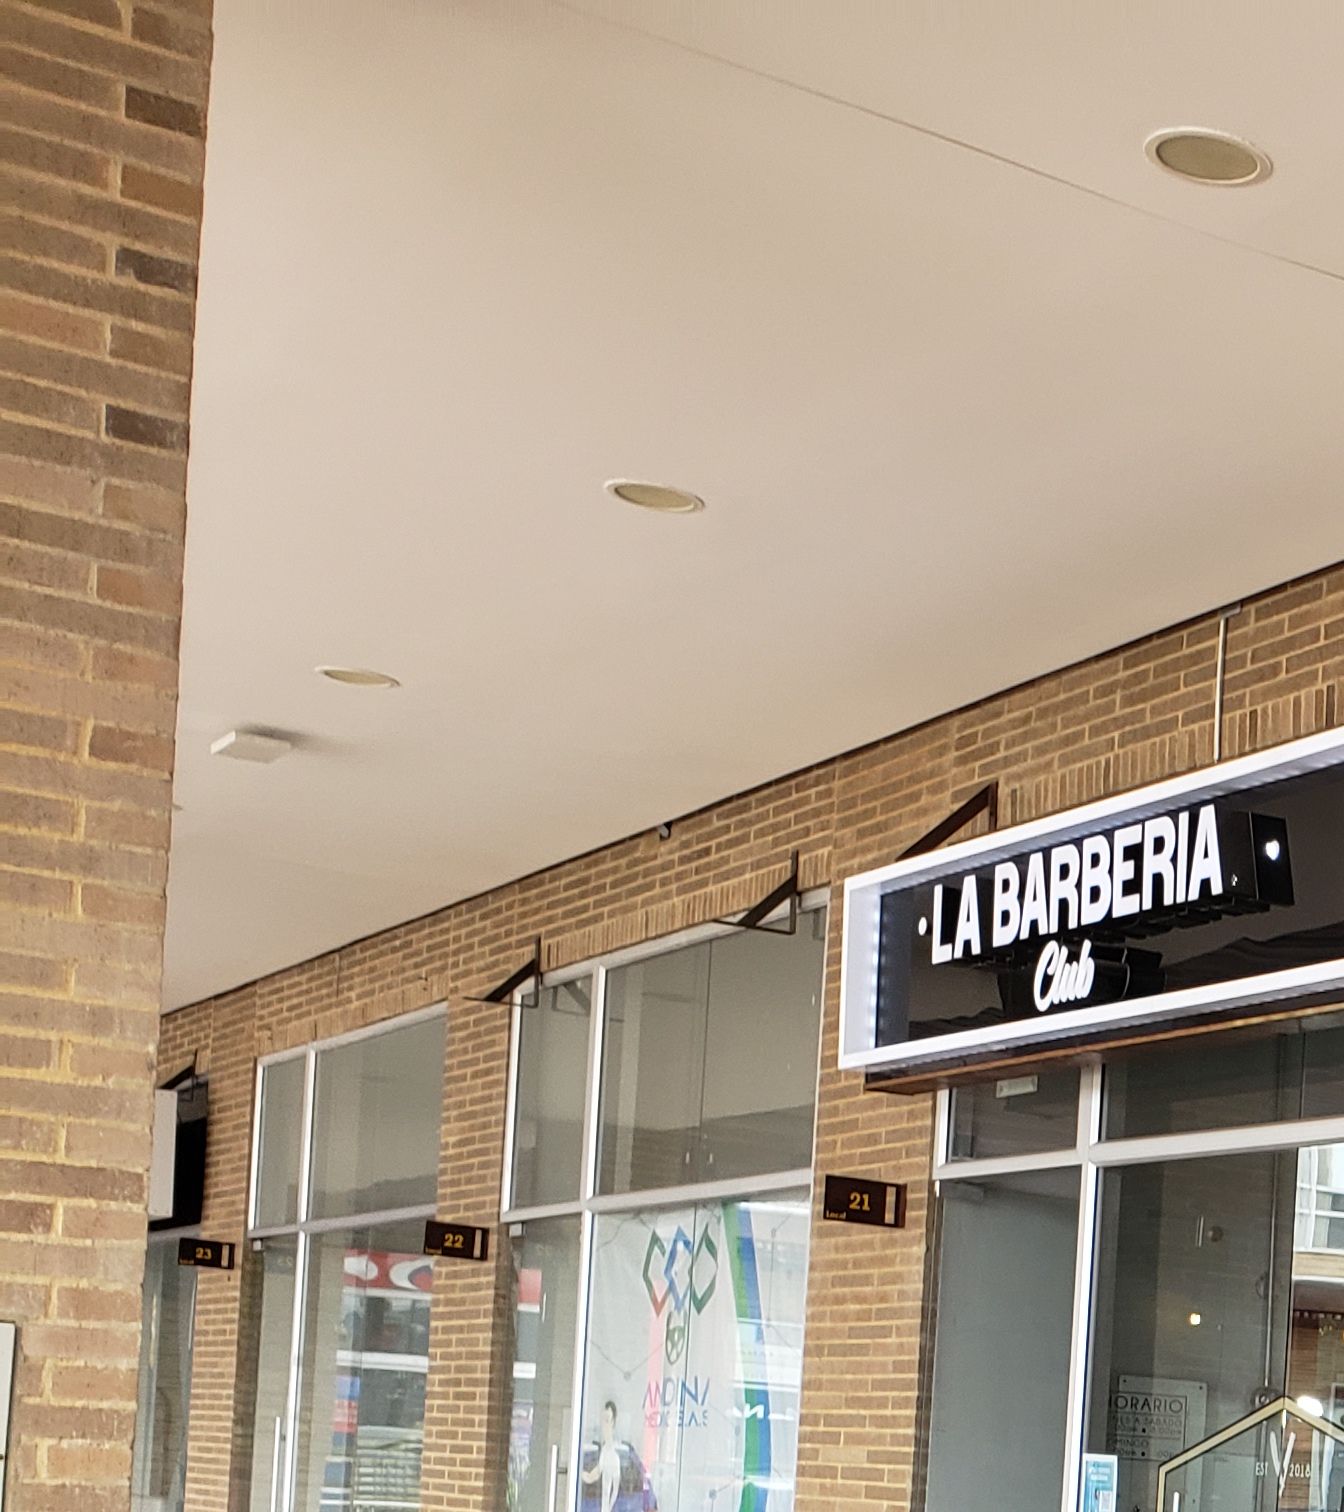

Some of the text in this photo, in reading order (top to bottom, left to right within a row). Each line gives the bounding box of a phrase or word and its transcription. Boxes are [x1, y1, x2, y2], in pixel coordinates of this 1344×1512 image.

[932, 804, 1223, 965] LA BARBERIA
[1034, 939, 1096, 1012] Club
[849, 1191, 870, 1211] 21
[444, 1233, 464, 1249] 22
[196, 1247, 212, 1260] 23
[1256, 1462, 1268, 1476] EST
